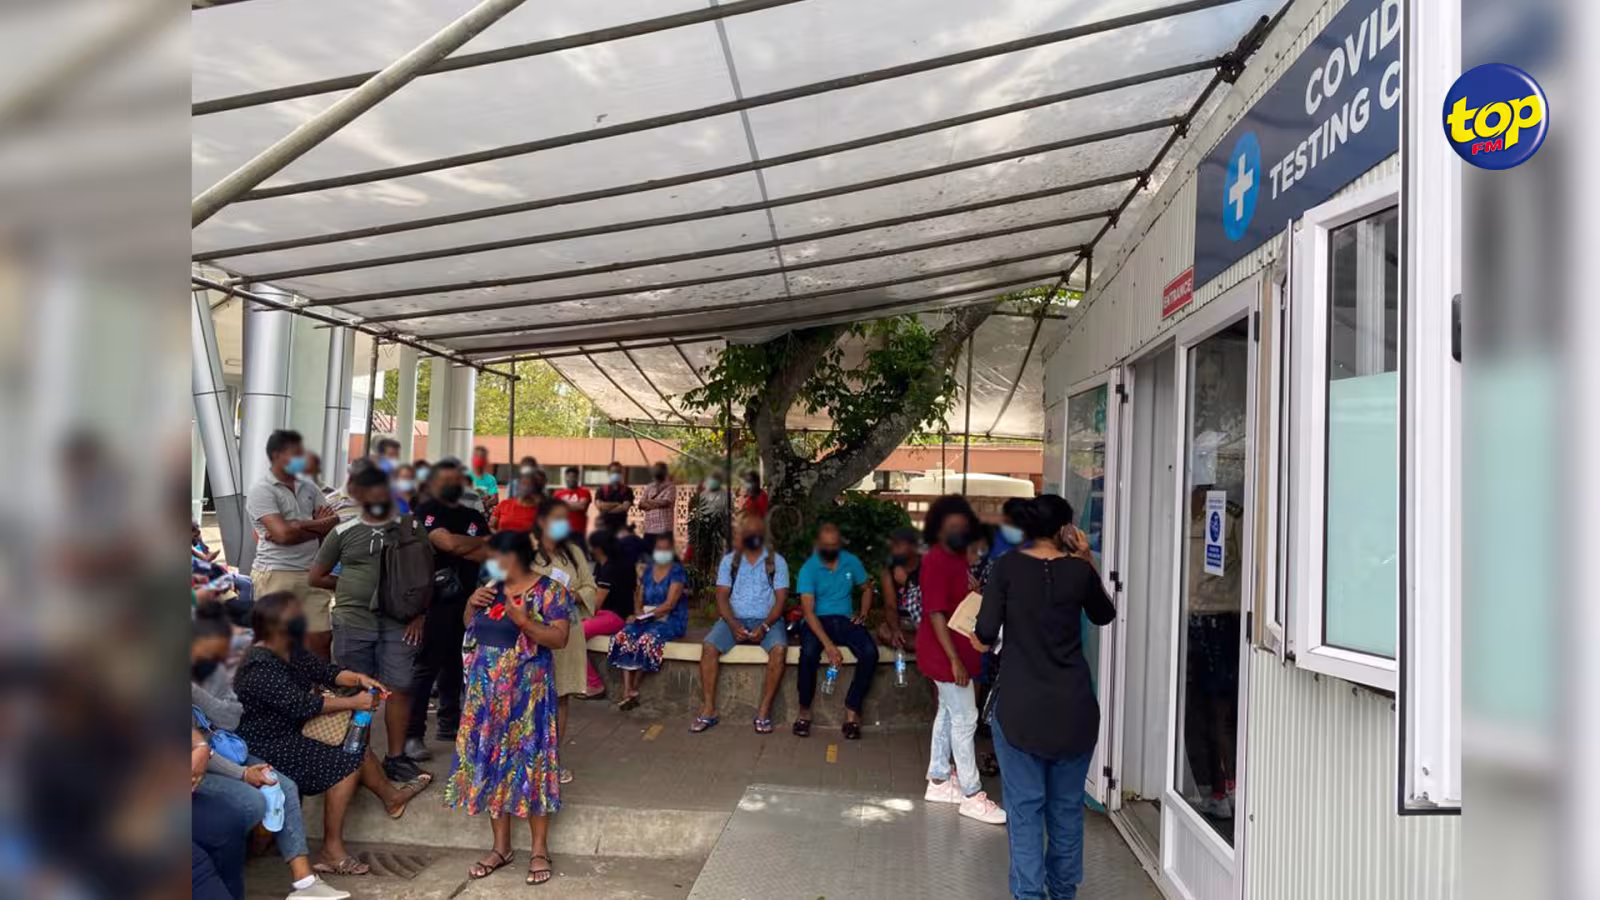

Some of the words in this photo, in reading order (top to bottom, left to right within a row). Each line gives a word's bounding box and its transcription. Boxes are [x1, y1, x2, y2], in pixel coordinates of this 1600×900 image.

[1305, 0, 1400, 115] COVID
[1269, 87, 1370, 200] TESTING
[1164, 278, 1192, 309] ENTRANCE
